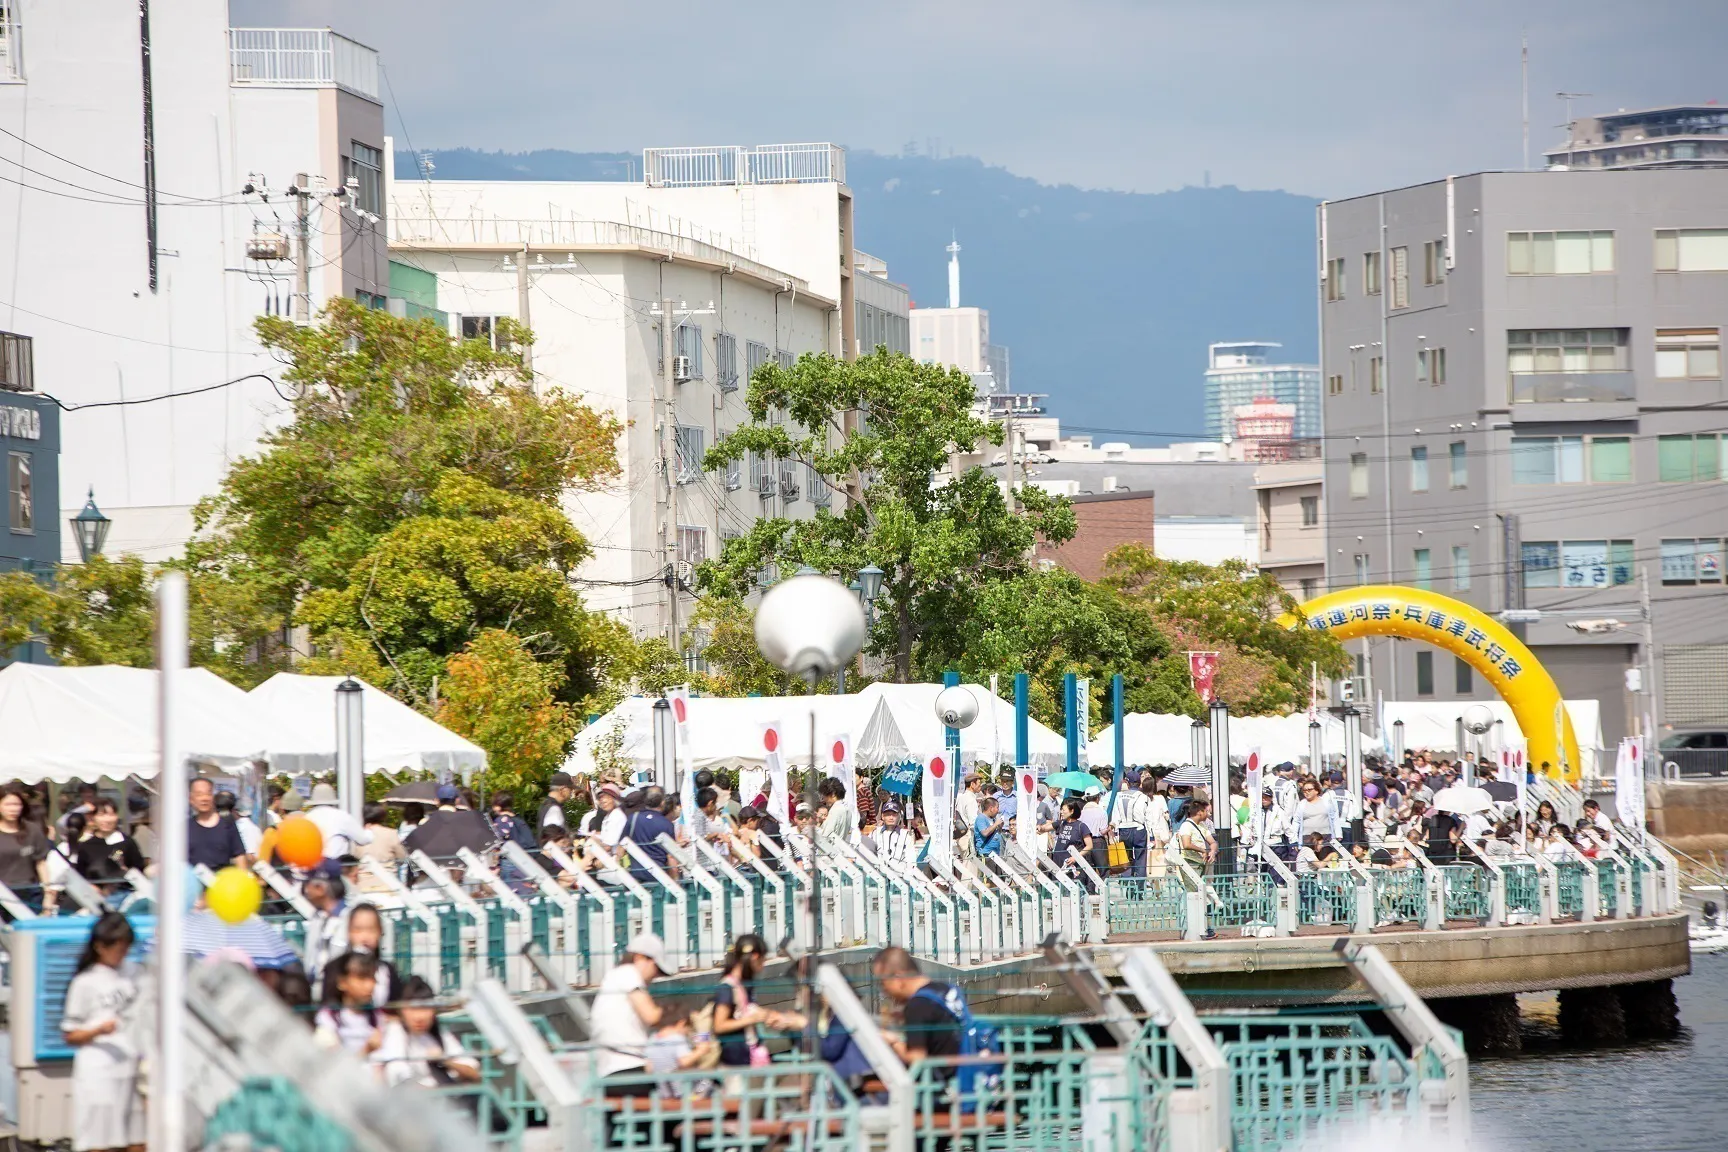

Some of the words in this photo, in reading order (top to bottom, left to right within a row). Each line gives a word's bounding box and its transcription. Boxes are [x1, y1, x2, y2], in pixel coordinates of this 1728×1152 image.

[1292, 603, 1523, 680] 庫運河祭・兵庫津武将祭
